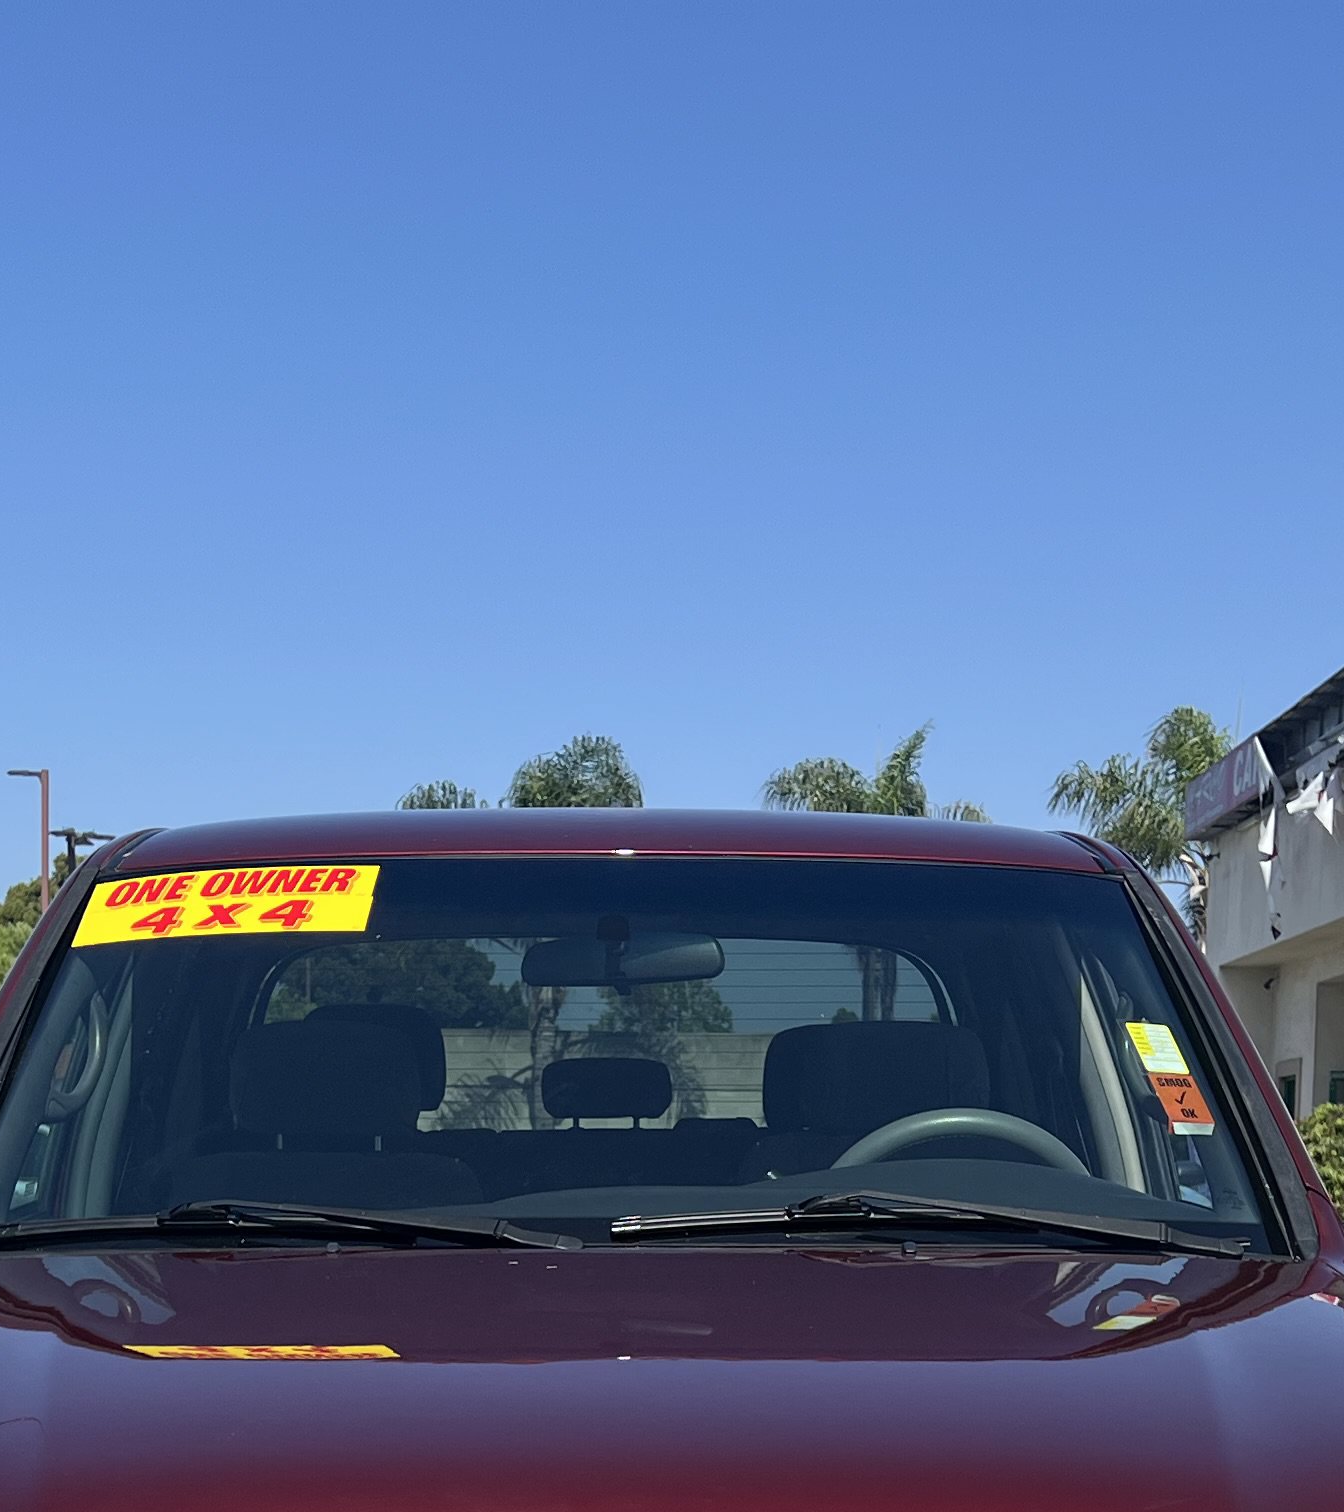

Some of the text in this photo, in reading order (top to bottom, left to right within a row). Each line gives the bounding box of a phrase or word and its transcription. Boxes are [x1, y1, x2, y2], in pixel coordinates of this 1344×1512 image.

[105, 868, 360, 909] ONE OWNER
[1156, 1077, 1192, 1089] SMOG
[1181, 1108, 1199, 1119] OK
